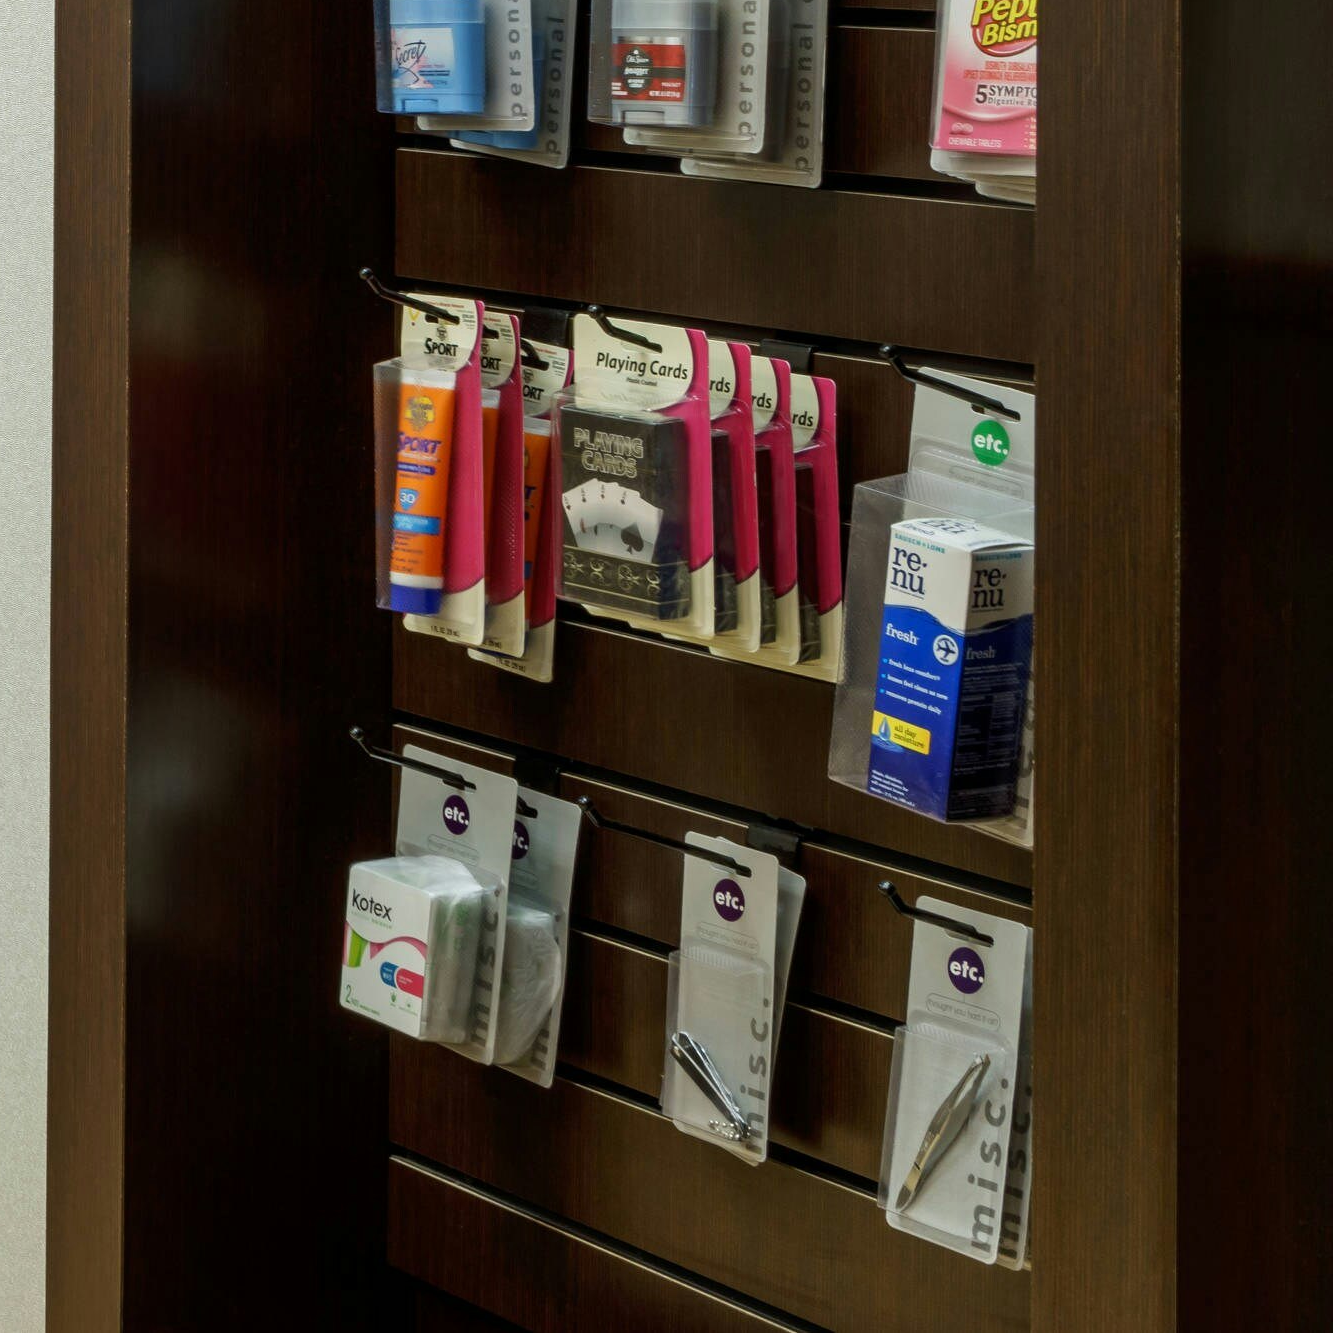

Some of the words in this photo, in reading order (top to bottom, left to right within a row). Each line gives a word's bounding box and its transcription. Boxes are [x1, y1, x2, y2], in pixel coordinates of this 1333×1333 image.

[395, 40, 426, 66] Secret
[546, 17, 566, 155] personal
[975, 85, 988, 104] 5
[792, 22, 815, 176] personal
[424, 337, 459, 357] SPORT
[597, 352, 648, 375] Playing
[649, 361, 688, 380] Cards
[574, 428, 644, 459] PLAYING
[974, 432, 1009, 455] etc.
[581, 451, 637, 479] CARDS
[399, 492, 414, 505] 30
[890, 568, 926, 595] nu
[972, 587, 1005, 608] nu
[885, 622, 919, 646] fresh
[444, 805, 469, 826] etc.
[714, 890, 745, 912] etc.
[949, 960, 984, 985] etc.
[971, 1077, 1009, 1253] misc.
